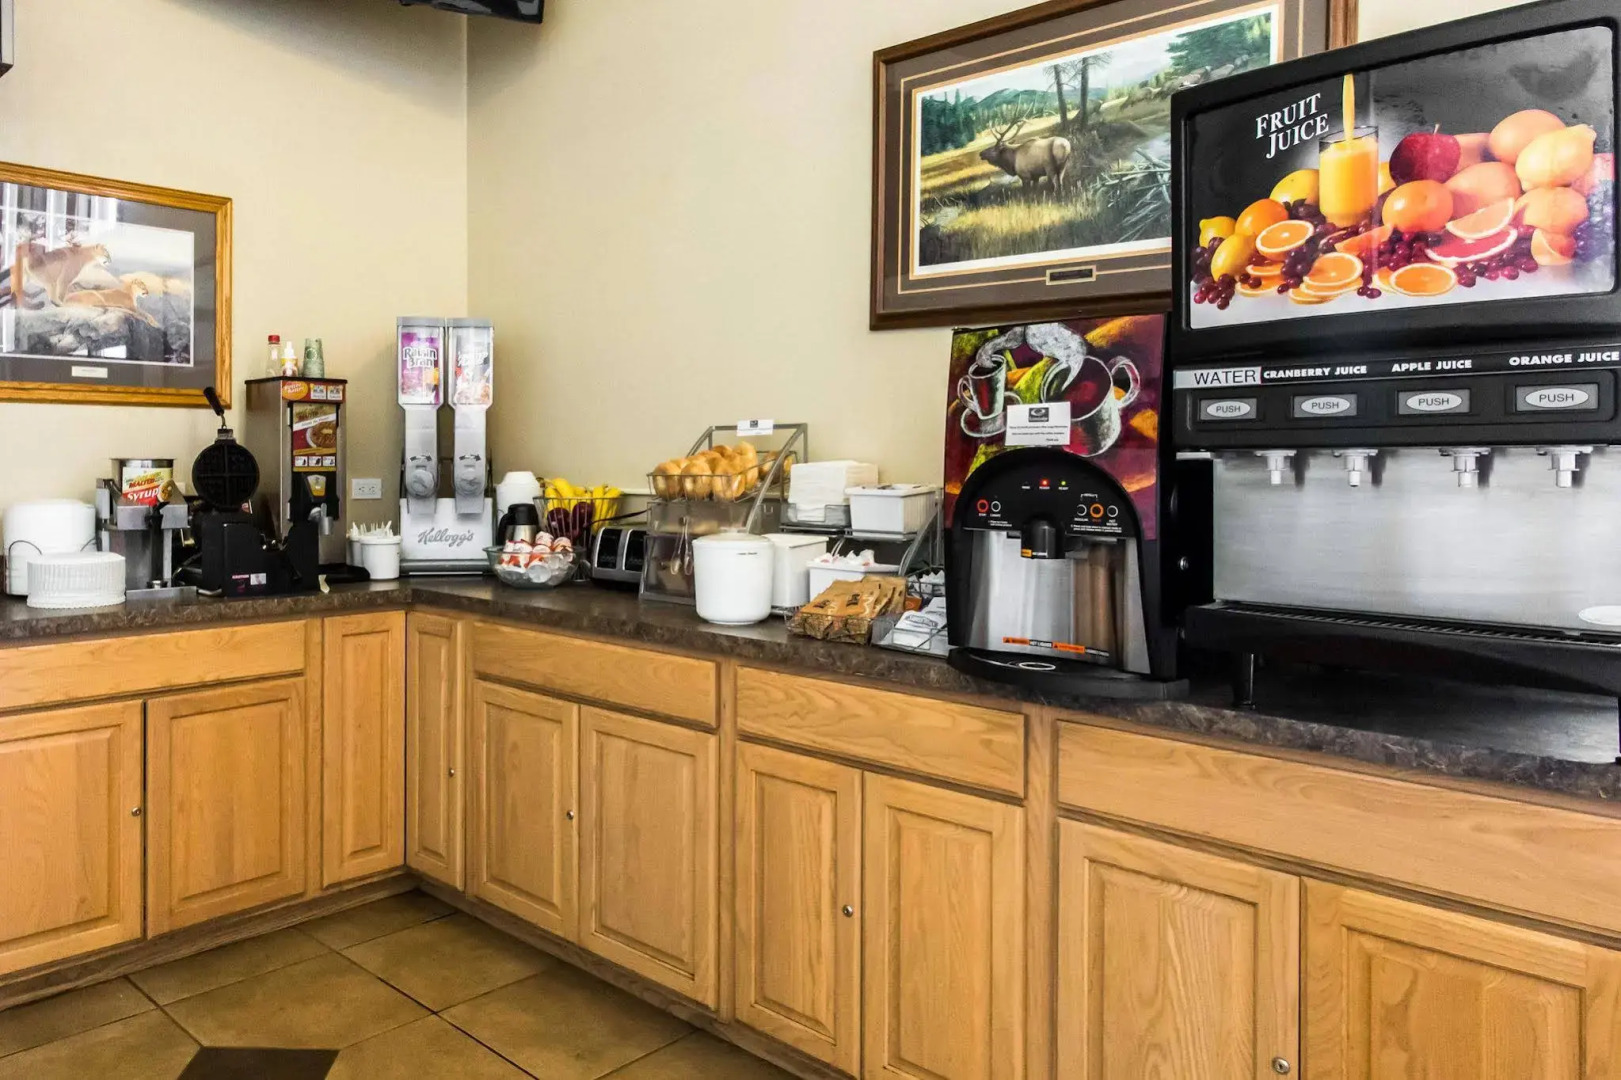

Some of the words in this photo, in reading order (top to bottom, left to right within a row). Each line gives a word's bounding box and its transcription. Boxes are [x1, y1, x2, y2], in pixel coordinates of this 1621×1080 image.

[1255, 92, 1321, 139] FRUIT
[1265, 113, 1330, 159] JUICE
[403, 347, 437, 360] Raisin
[1508, 354, 1573, 366] ORANGE
[1577, 351, 1620, 363] JUICE
[1263, 367, 1331, 379] CRANBERRY
[1334, 365, 1368, 375] JUICE
[1391, 361, 1432, 372] APPLE
[1436, 359, 1472, 370] JUICE
[1194, 369, 1256, 385] WATER
[1418, 397, 1450, 407] PUSH
[1538, 393, 1575, 403] PUSH
[1215, 405, 1241, 413] PUSH
[1311, 401, 1340, 410] PUSH
[417, 527, 475, 548] Kellogg's
